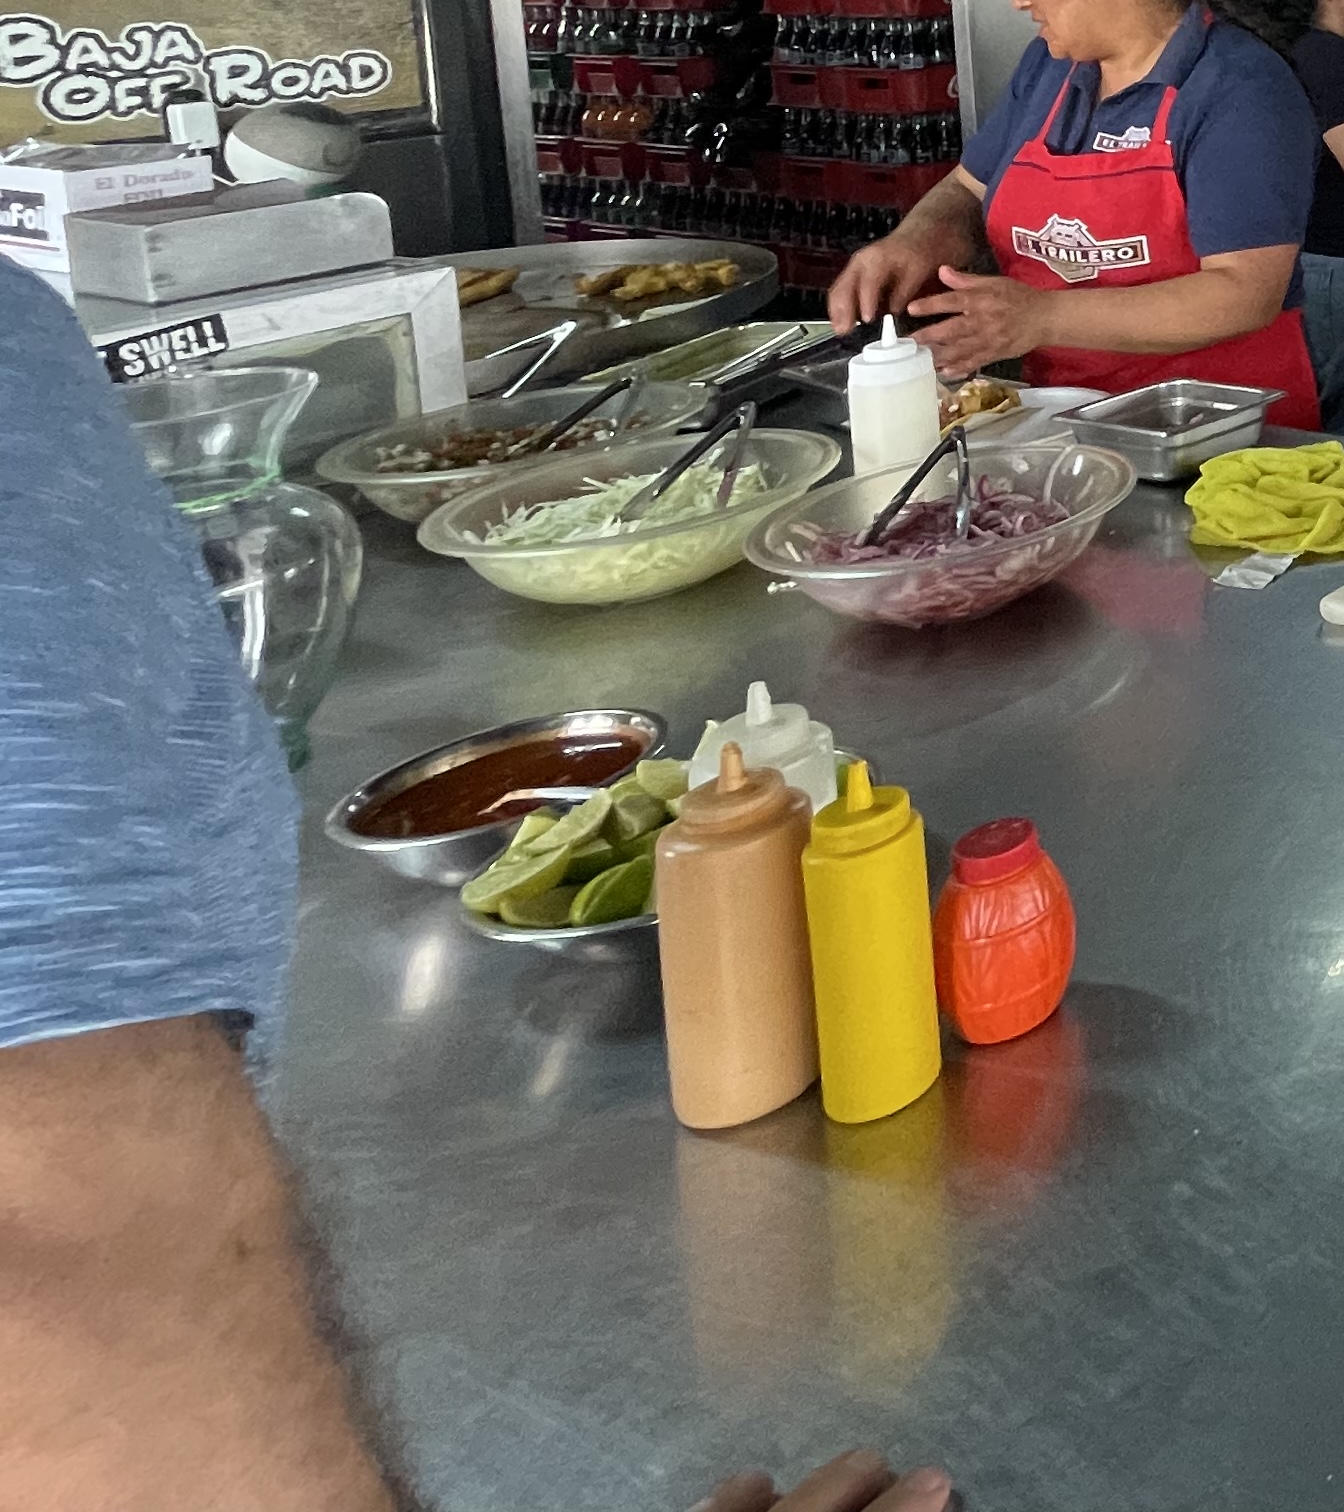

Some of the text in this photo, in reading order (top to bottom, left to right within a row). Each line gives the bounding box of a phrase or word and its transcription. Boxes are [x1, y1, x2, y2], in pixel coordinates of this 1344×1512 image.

[0, 17, 203, 83] BAJA
[45, 50, 384, 119] OFF ROAD
